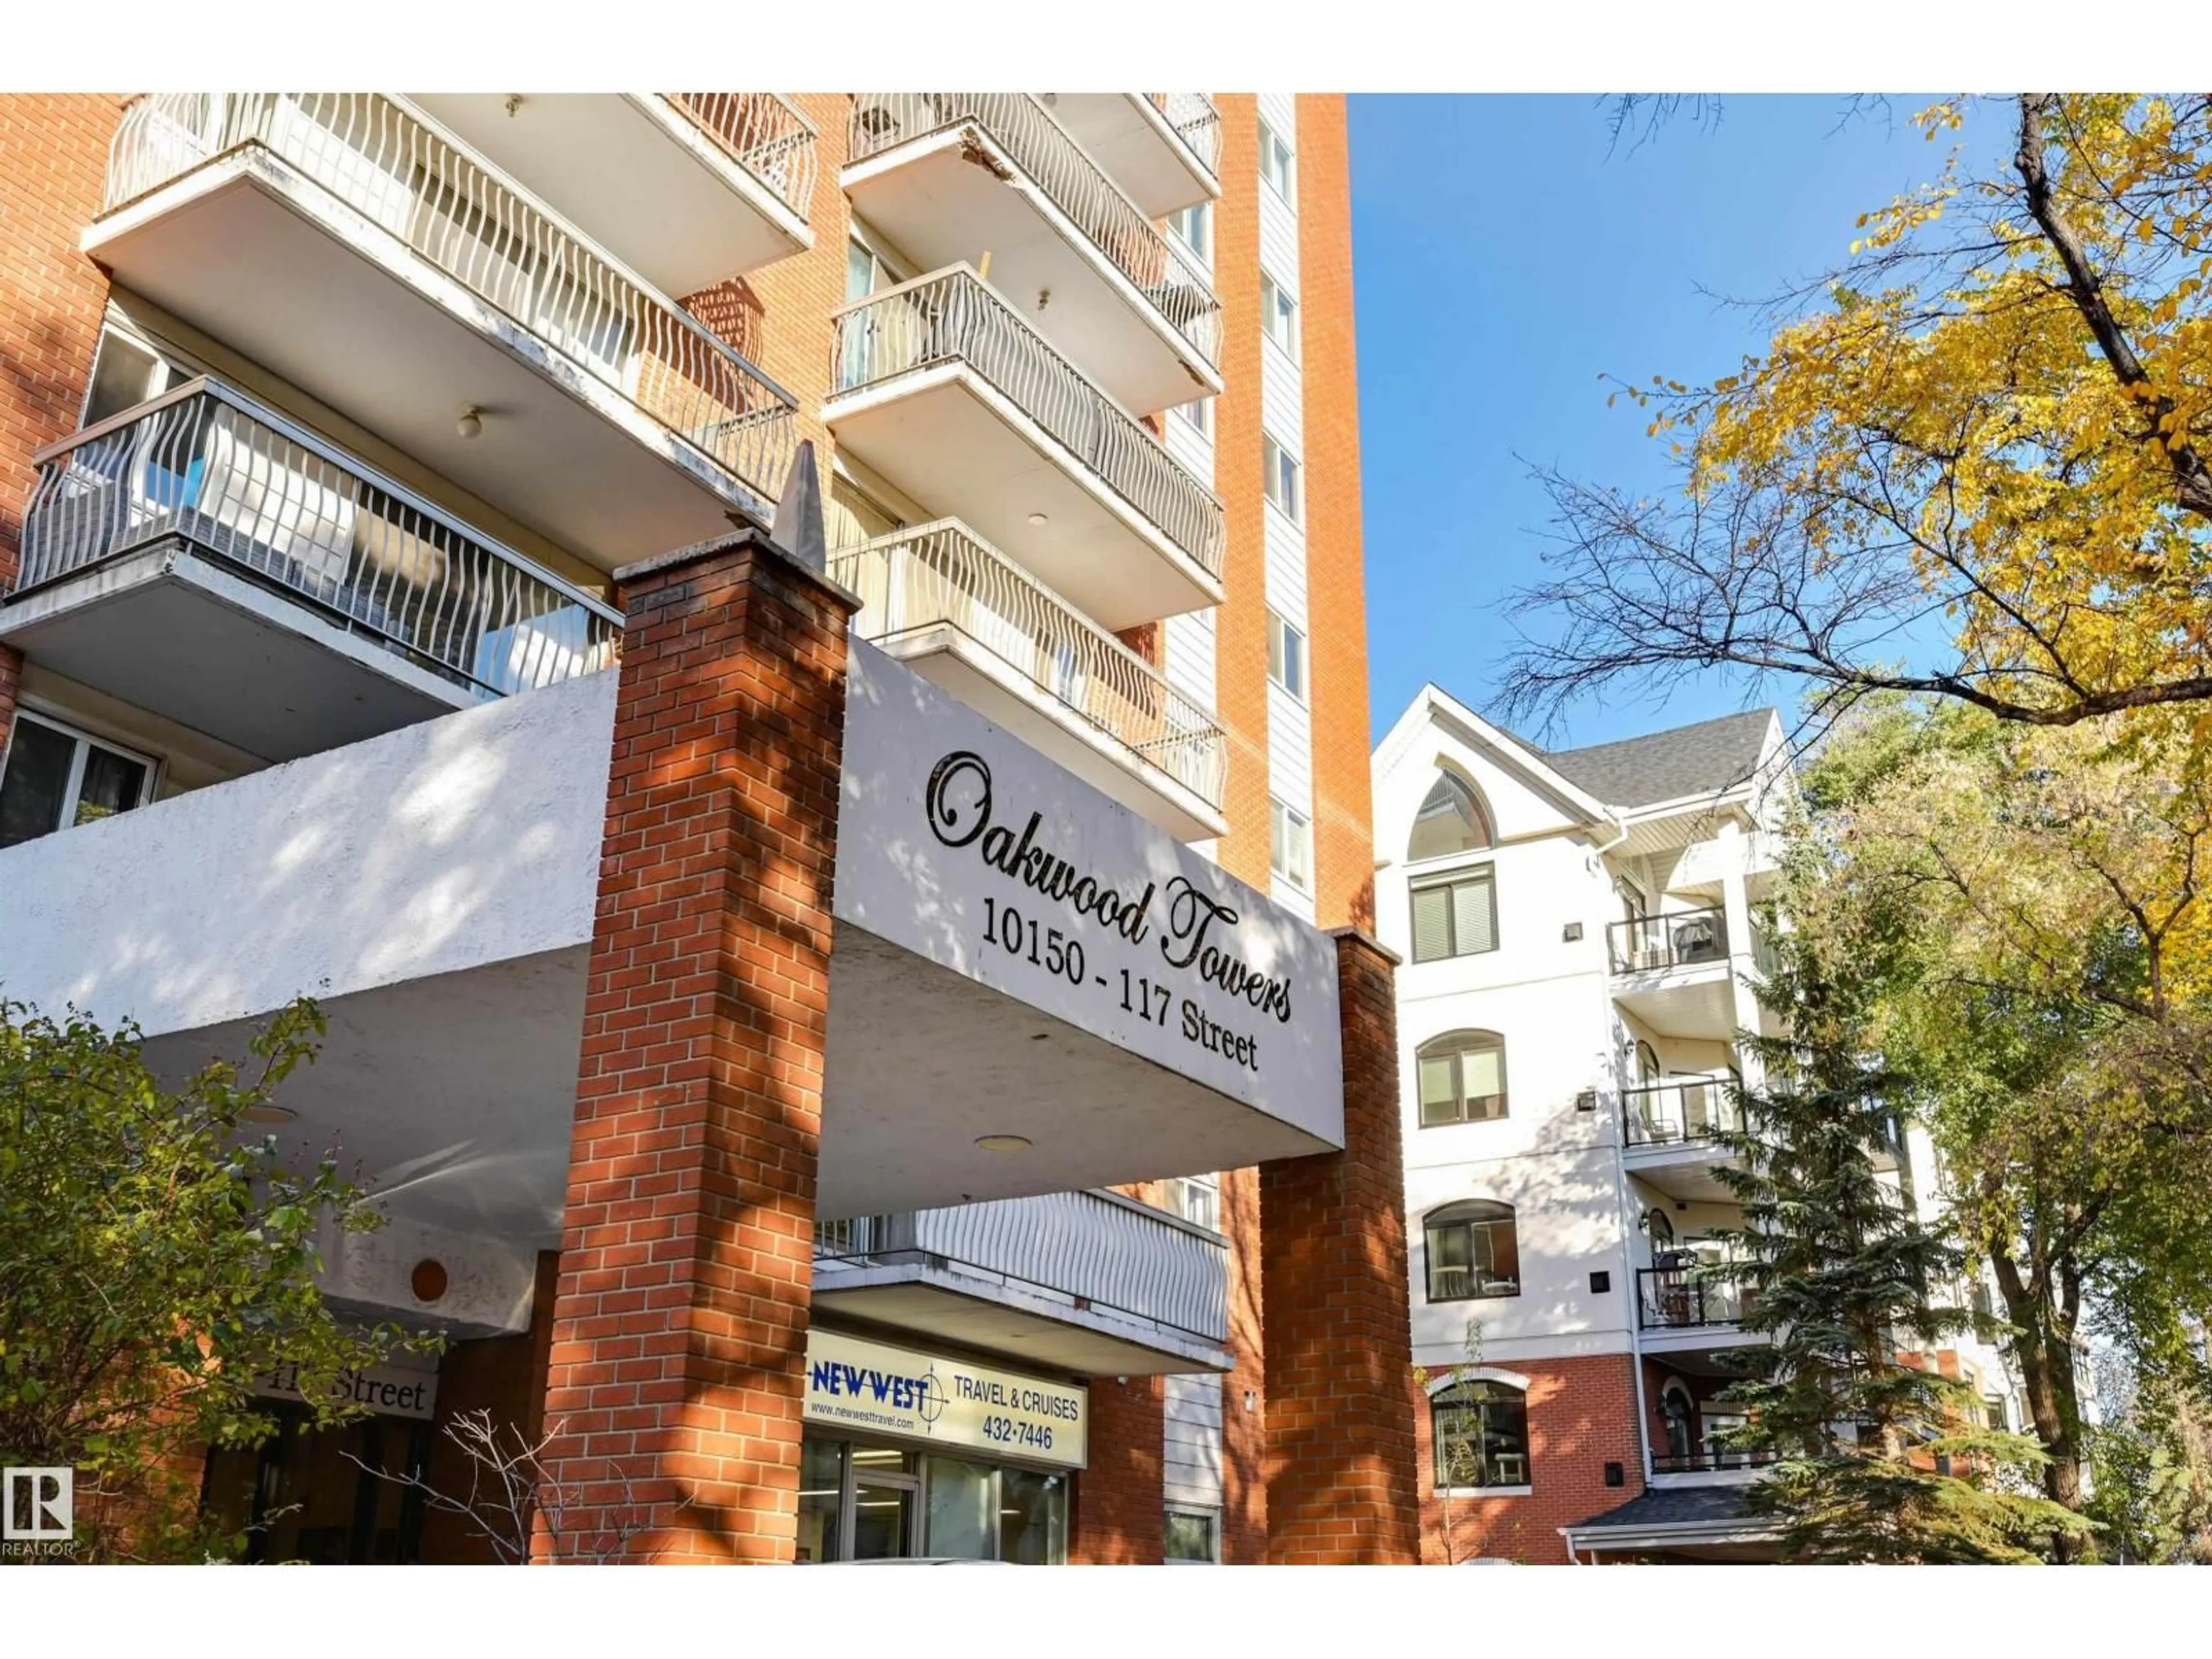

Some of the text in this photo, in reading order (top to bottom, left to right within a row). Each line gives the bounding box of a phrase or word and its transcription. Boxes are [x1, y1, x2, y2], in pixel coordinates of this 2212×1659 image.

[926, 751, 1291, 1022] Oakwood Towers
[983, 897, 1258, 1071] 10150 - 117 Street
[331, 1367, 426, 1411] Street
[954, 1375, 1078, 1421] TRAVEL & CRUISES
[811, 1402, 915, 1430] www.newwesttravel.com
